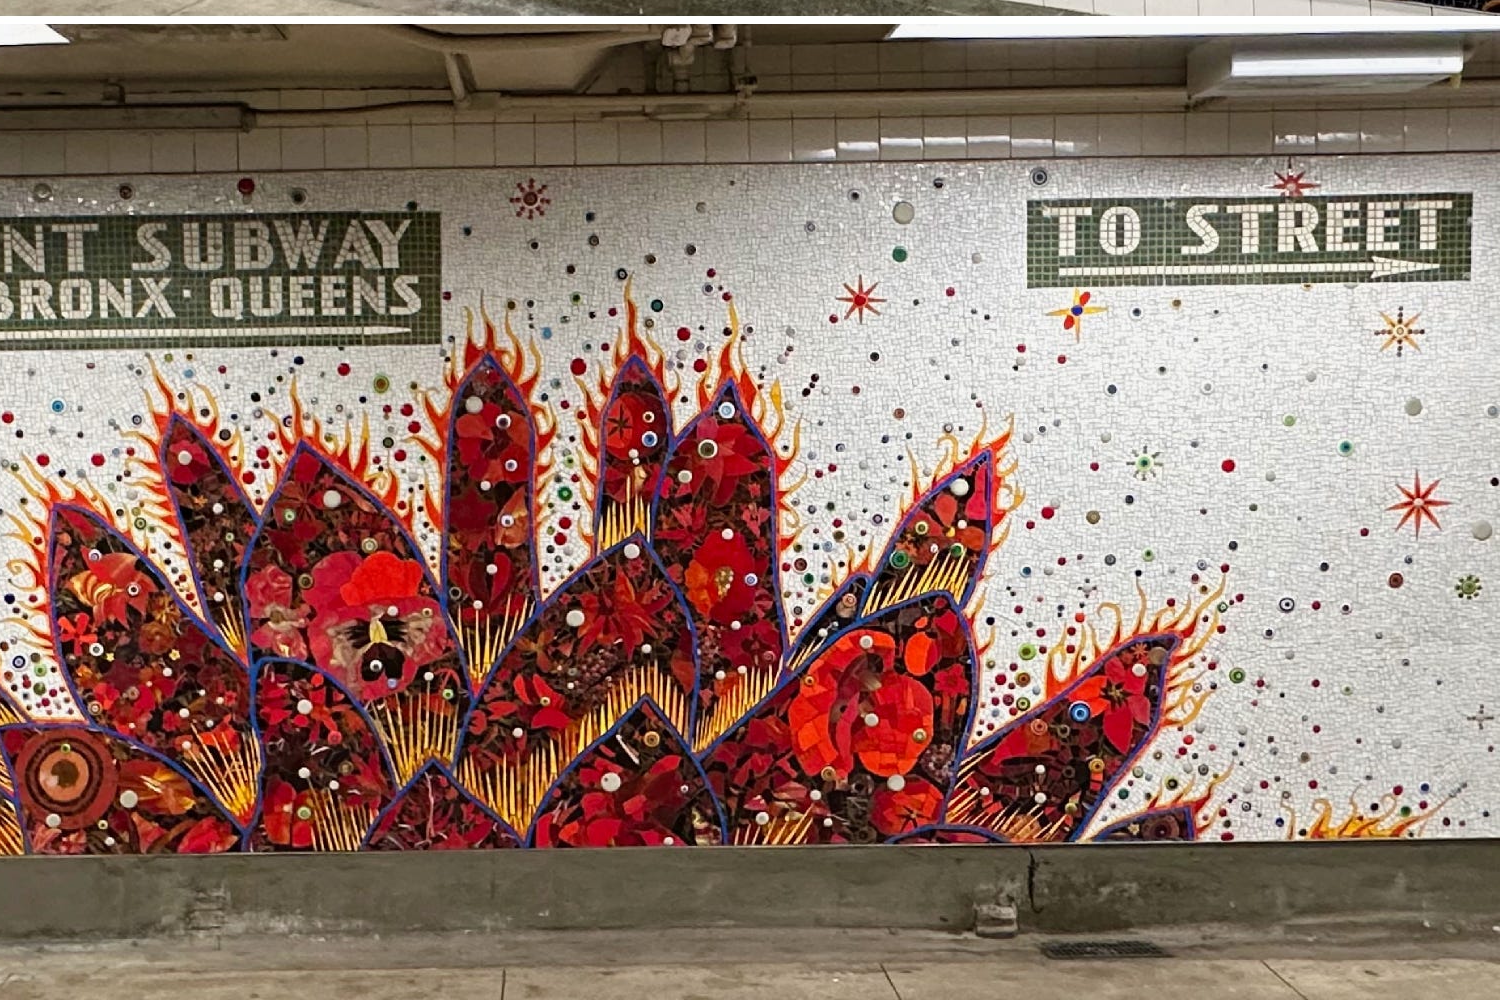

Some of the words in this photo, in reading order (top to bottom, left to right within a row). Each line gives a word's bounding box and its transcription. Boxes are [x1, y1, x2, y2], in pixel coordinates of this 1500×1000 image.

[130, 219, 412, 272] SUBWAY
[1042, 205, 1141, 257] TO
[1180, 201, 1453, 255] STREET
[209, 274, 422, 321] QUEENS
